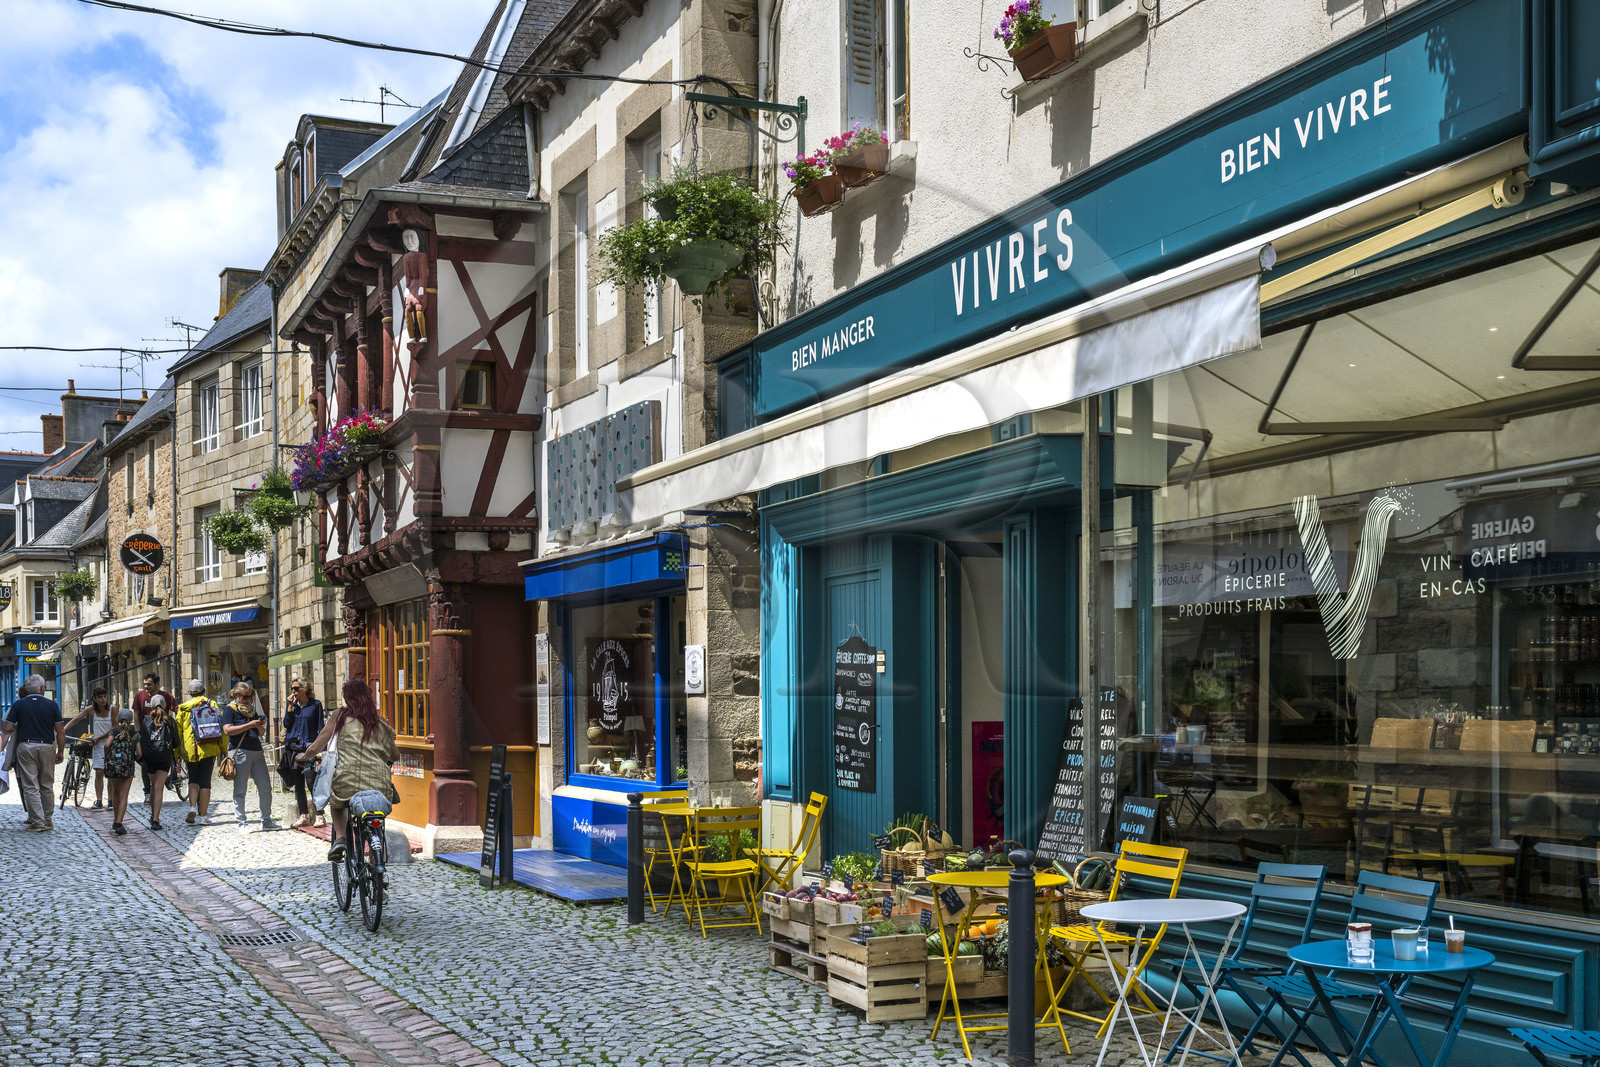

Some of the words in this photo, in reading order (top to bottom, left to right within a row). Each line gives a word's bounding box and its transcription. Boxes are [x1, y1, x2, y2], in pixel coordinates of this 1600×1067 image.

[1221, 126, 1281, 183] BIEN
[1293, 74, 1392, 148] VIVRE
[951, 208, 1074, 316] VIVRES
[791, 341, 817, 372] BIEN
[821, 316, 875, 359] MANGER
[1420, 554, 1451, 572] VIN
[1471, 543, 1518, 568] CAFÉ
[1224, 572, 1286, 592] ÉPICERIE
[1420, 577, 1486, 598] EN-CAS
[1179, 599, 1241, 617] PRODUITS
[1247, 595, 1286, 612] FRAIS
[193, 614, 215, 627] HORIZON
[215, 612, 232, 624] MARIN
[592, 682, 601, 701] 19
[620, 681, 628, 701] 15
[1063, 739, 1079, 751] CRAFT
[1059, 768, 1079, 781] FRUITS
[1054, 783, 1082, 796] FROMAGES
[1053, 797, 1076, 808] VIANDES
[1045, 821, 1077, 834] CONFISERIES
[1120, 821, 1146, 835] MAISON
[1042, 832, 1068, 843] CONDIMENTS
